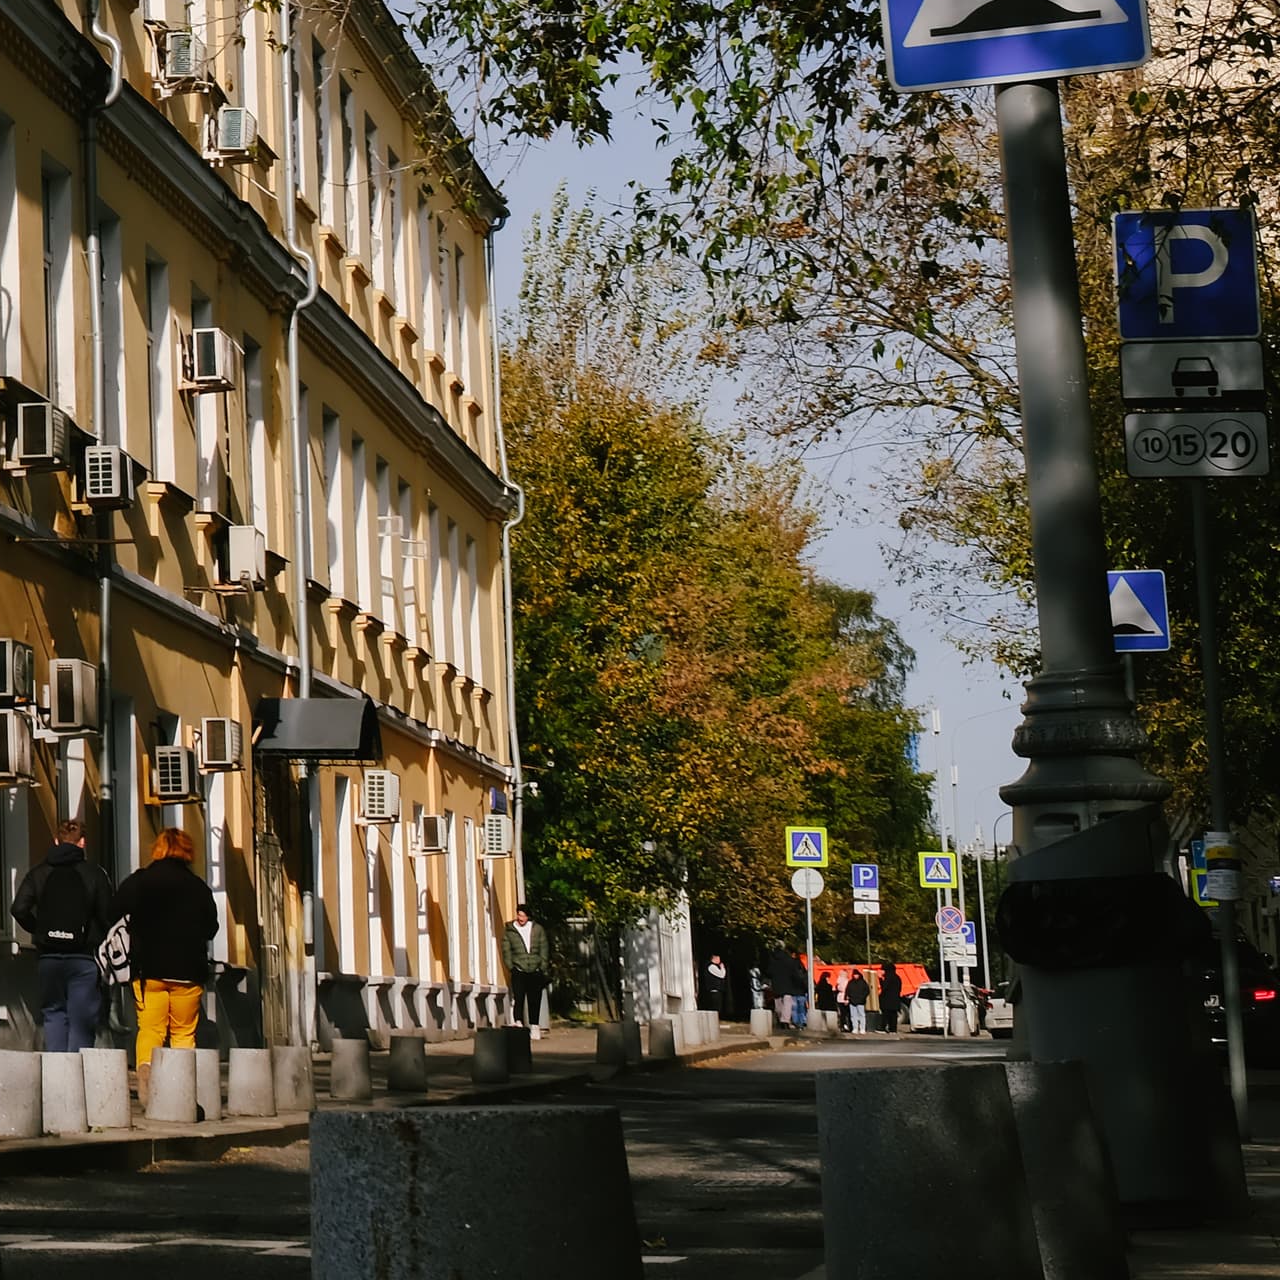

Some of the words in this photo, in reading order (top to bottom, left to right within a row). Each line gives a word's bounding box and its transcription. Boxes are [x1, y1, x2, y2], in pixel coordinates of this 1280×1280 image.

[1142, 437, 1163, 453] 10
[1172, 434, 1198, 456] 15
[1209, 431, 1251, 458] 20
